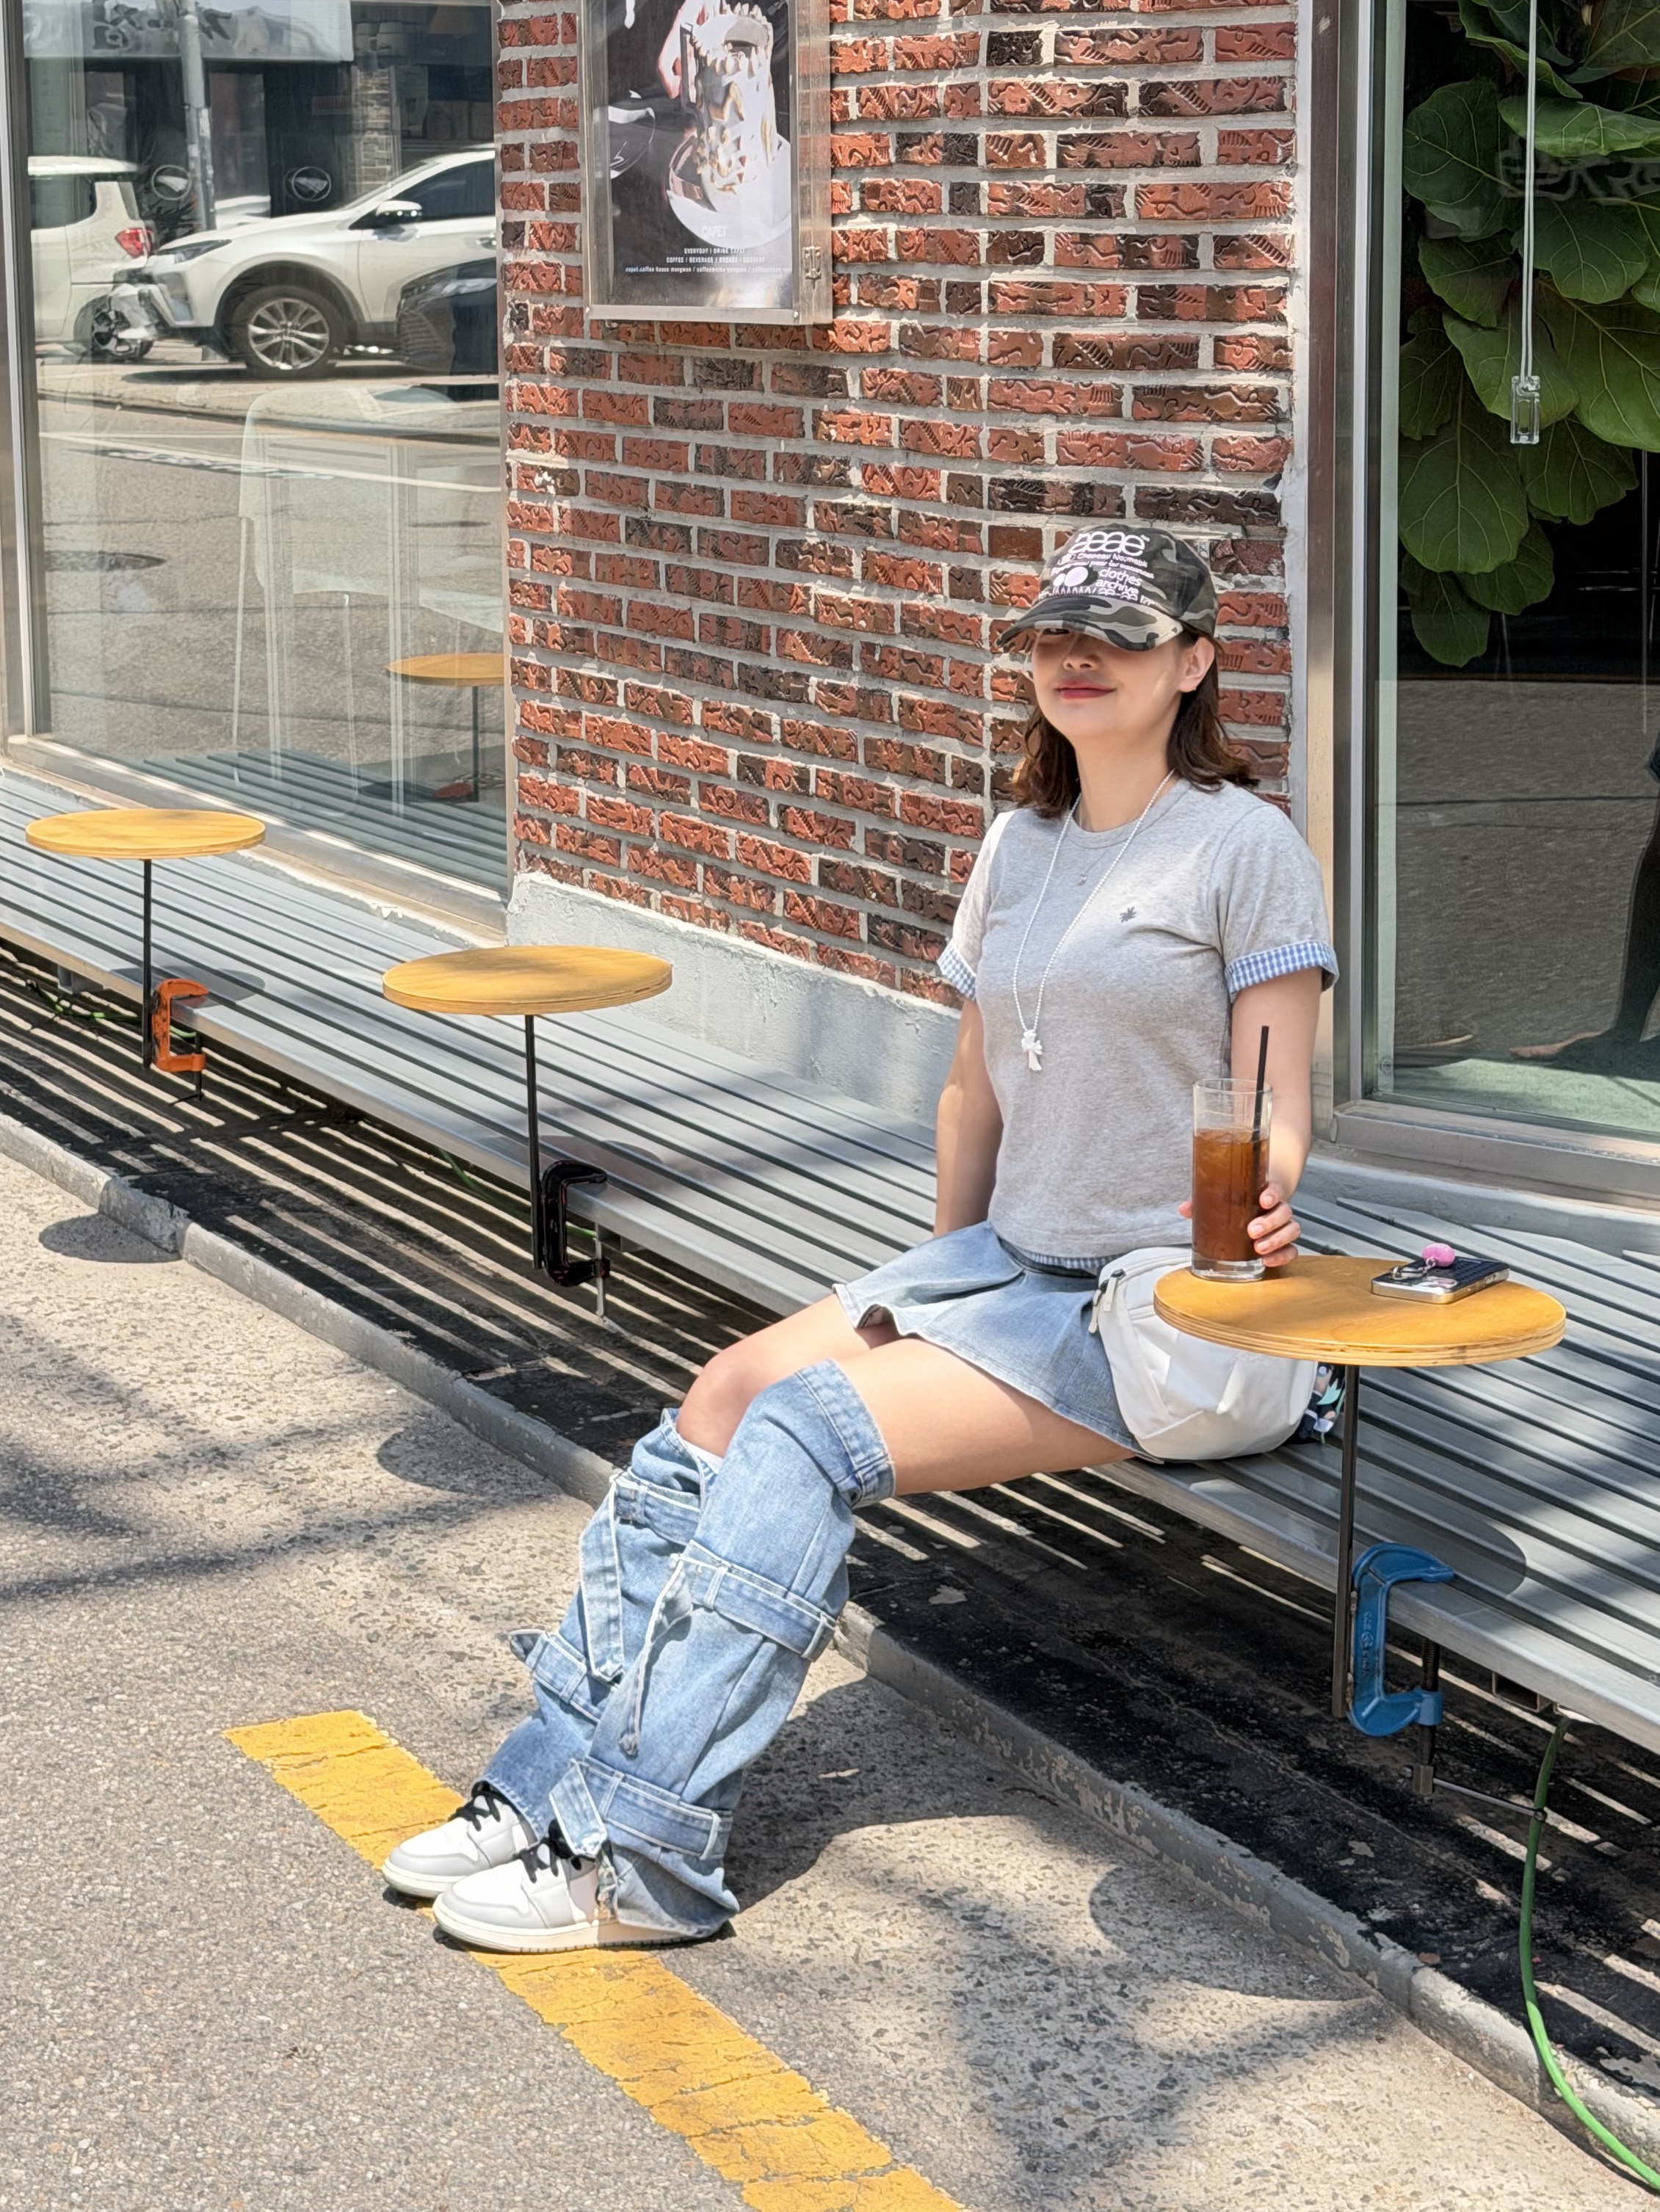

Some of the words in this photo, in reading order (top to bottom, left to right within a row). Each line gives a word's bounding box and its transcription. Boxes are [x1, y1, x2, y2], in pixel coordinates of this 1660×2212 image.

[700, 225, 728, 239] CAPET
[1098, 567, 1143, 587] clothes
[1095, 579, 1139, 595] archive
